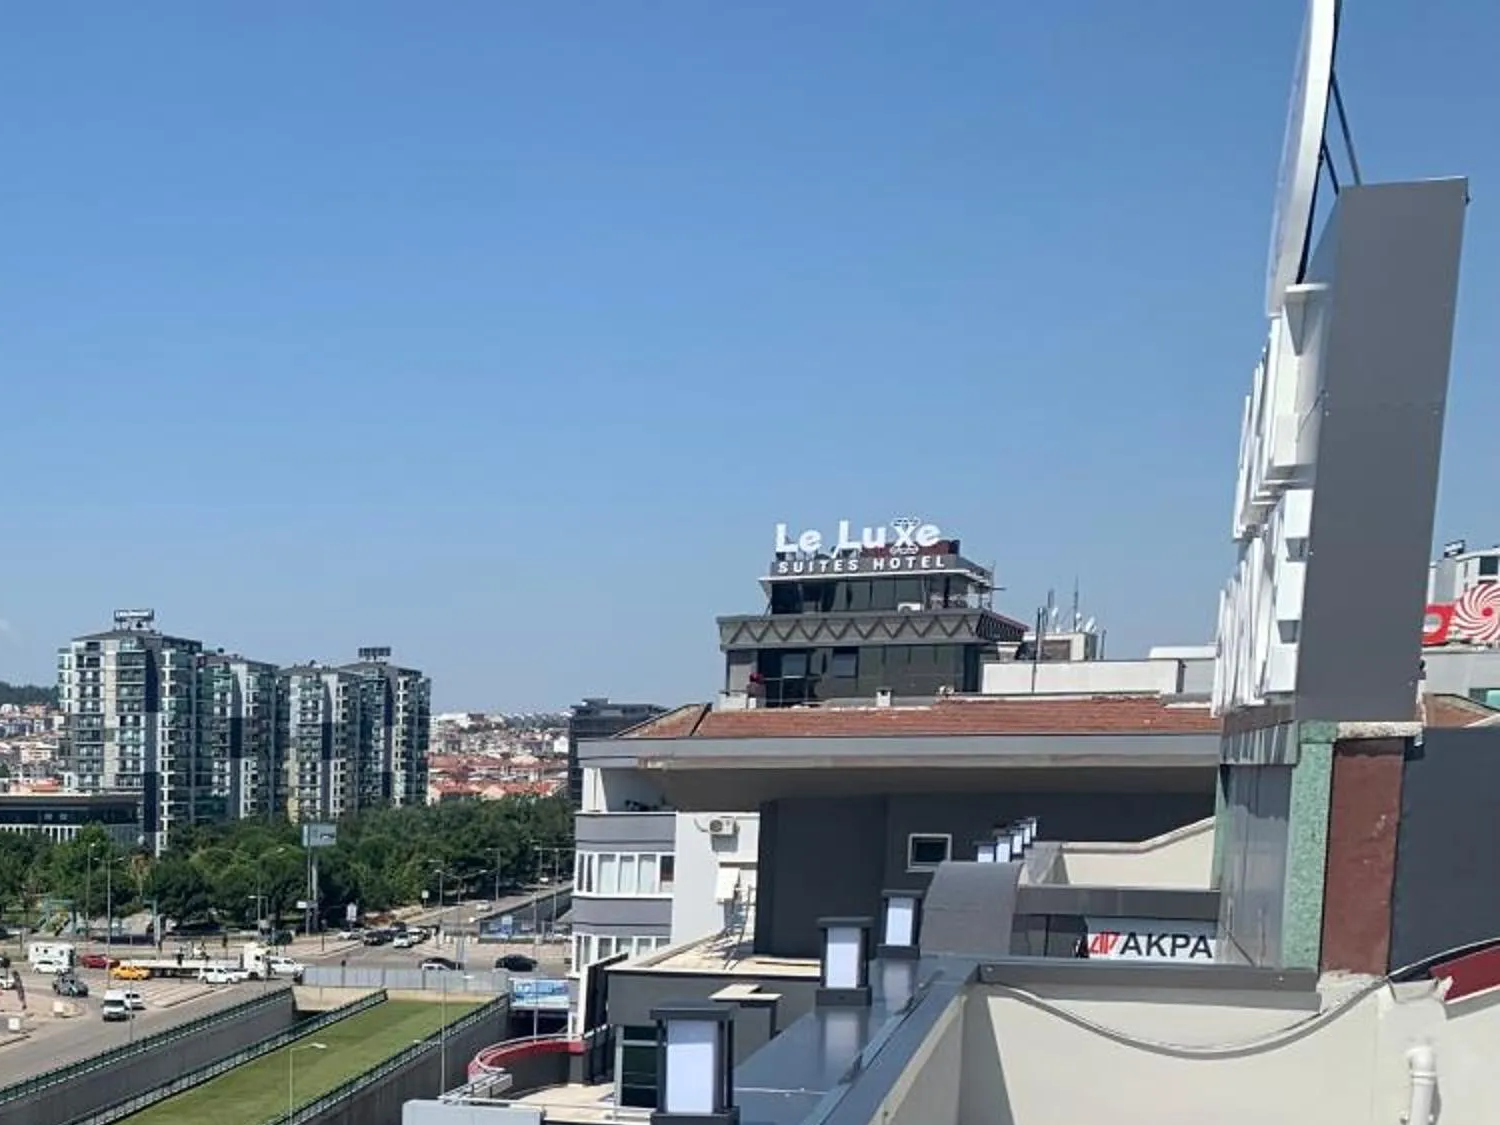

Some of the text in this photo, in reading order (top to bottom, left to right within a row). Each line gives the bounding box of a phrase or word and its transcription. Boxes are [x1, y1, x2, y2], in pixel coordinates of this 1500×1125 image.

[776, 523, 822, 552] Le
[778, 555, 945, 574] SUITES HOTEL
[1120, 931, 1213, 959] AKPA
